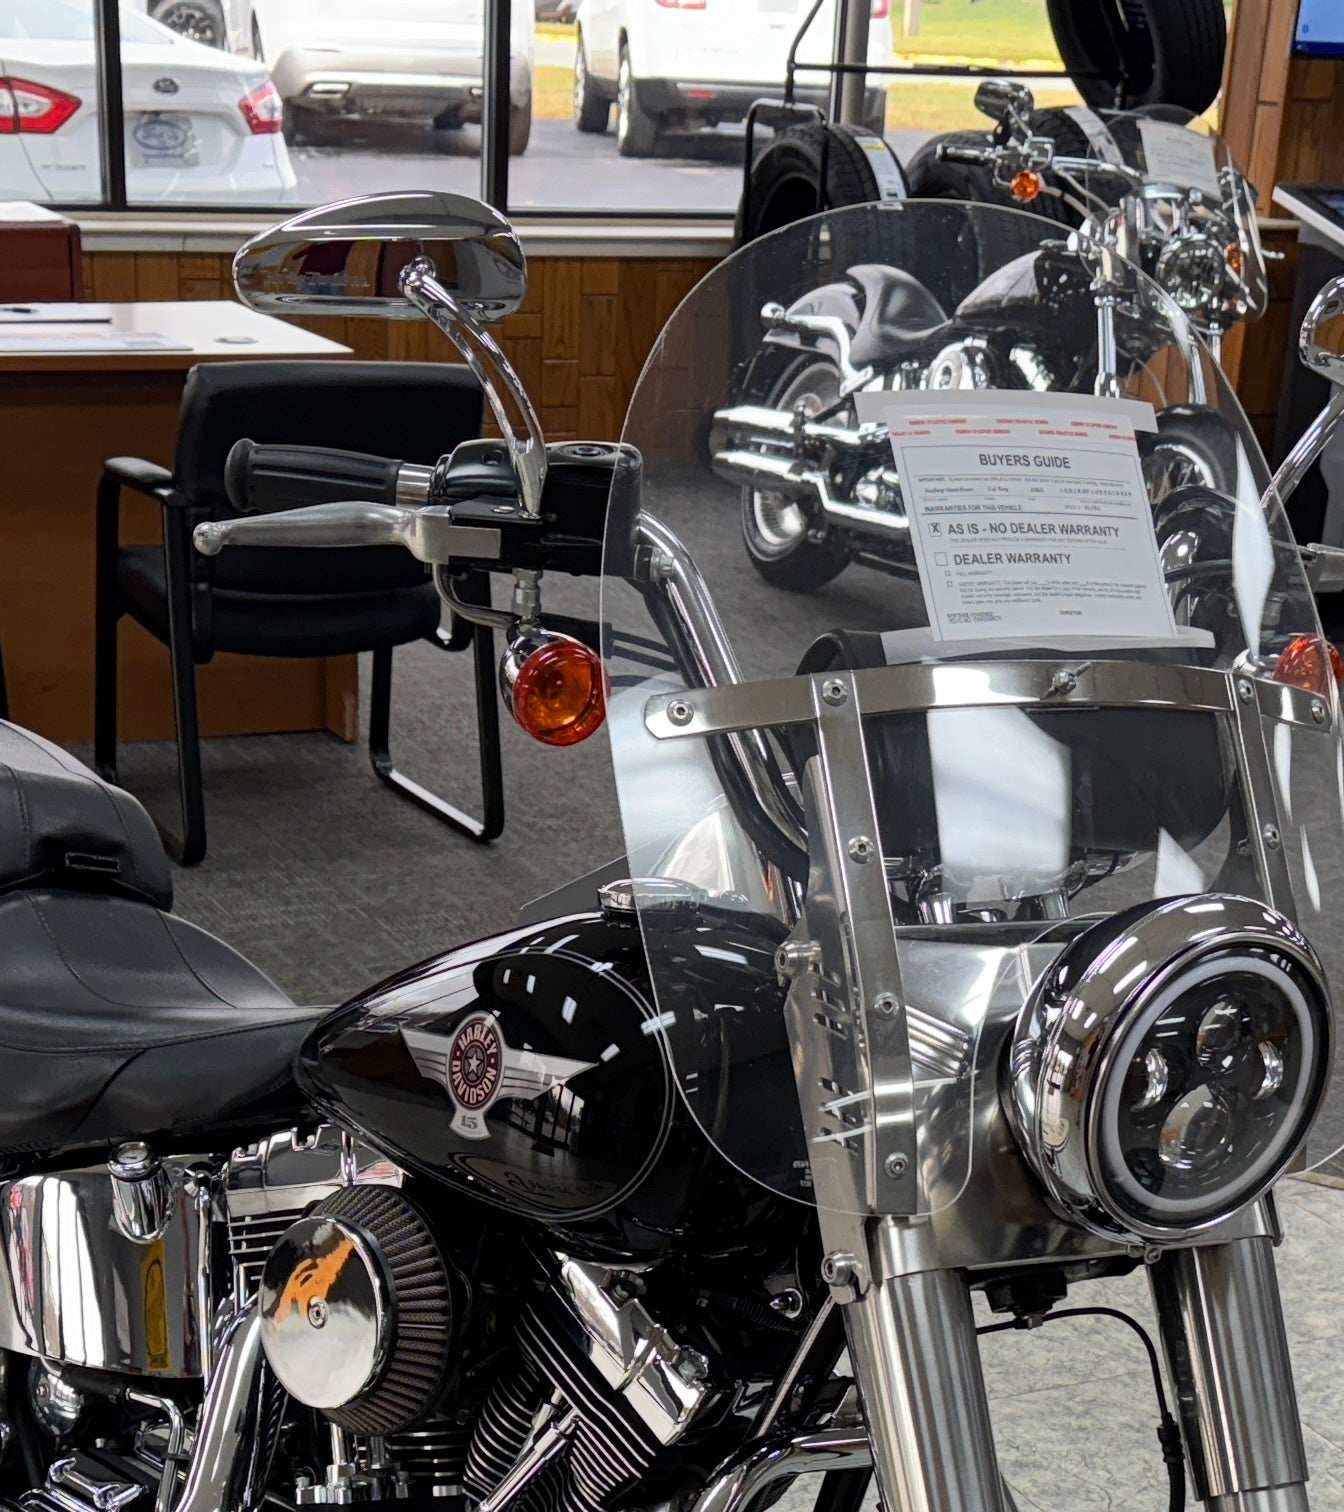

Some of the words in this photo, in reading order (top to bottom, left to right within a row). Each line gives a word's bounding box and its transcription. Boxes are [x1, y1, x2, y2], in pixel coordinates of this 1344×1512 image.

[978, 453, 1031, 467] BUYERS
[1033, 455, 1071, 469] GUIDE
[948, 523, 965, 535] AS
[967, 523, 979, 535] IS
[989, 522, 1007, 534] NO
[1009, 522, 1056, 535] DEALER
[1057, 523, 1120, 537] WARRANTY
[953, 553, 1004, 565] DEALER
[1005, 552, 1071, 565] WARRANTY
[457, 1023, 498, 1055] HARLEY
[452, 1059, 497, 1104] DAVIDSON
[461, 1114, 478, 1130] 15
